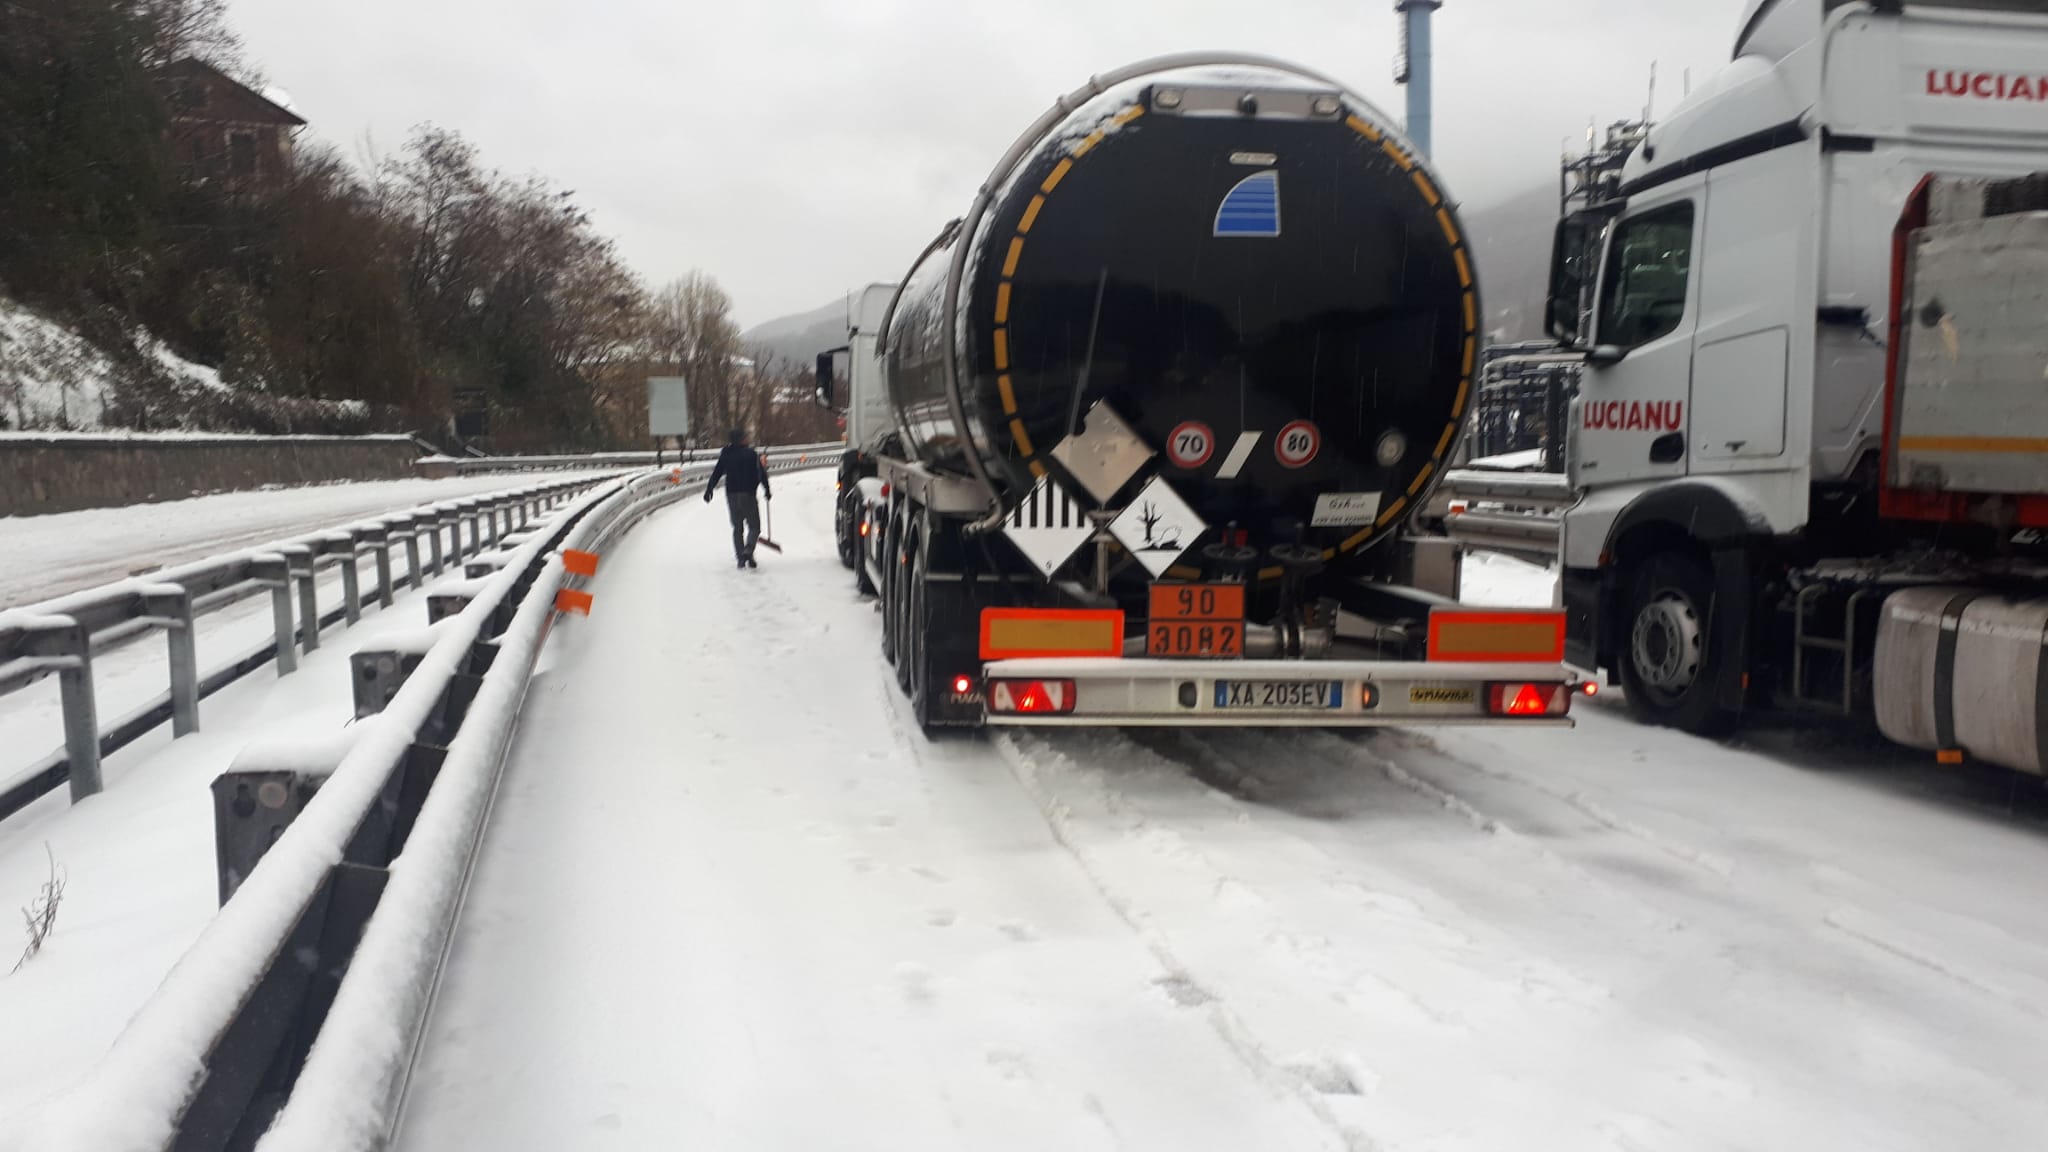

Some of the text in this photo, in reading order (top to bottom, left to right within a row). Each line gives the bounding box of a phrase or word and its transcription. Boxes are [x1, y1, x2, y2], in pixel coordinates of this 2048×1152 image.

[1583, 400, 1682, 431] LUCIANU
[1177, 434, 1203, 453] 70
[1287, 433, 1309, 452] 80
[1178, 588, 1215, 616] 90
[1155, 625, 1235, 654] 3082
[1230, 682, 1254, 705] XA
[1262, 682, 1328, 705] 203EV
